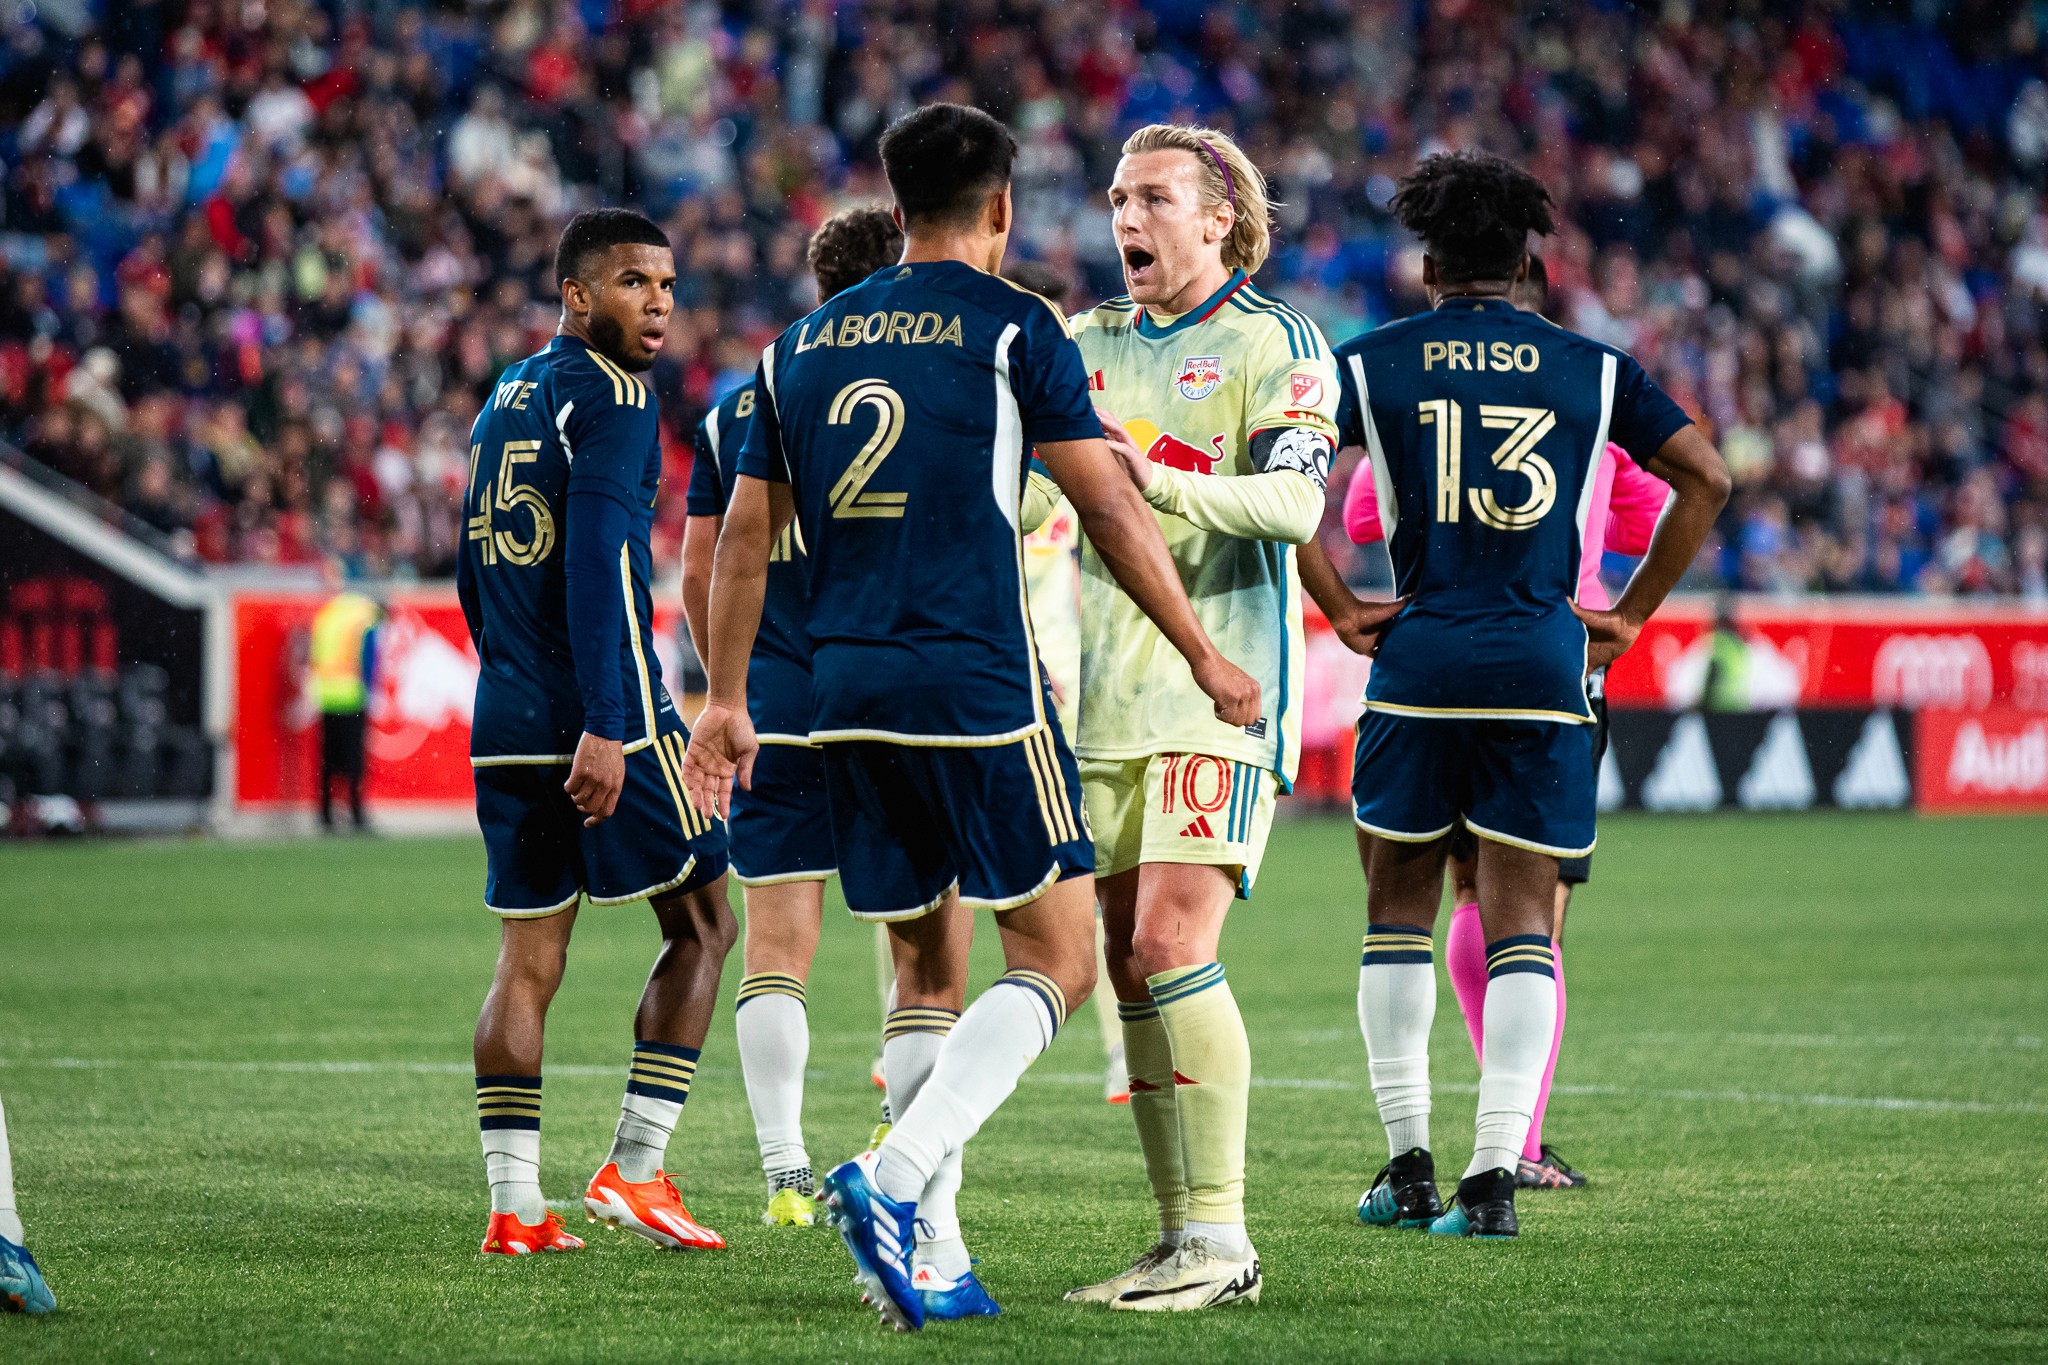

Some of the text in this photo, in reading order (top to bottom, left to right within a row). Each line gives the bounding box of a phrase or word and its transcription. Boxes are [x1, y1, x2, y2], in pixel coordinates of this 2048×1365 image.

[795, 311, 963, 354] LABORDA
[1423, 341, 1540, 373] PRISO
[1294, 377, 1311, 387] MLS
[827, 378, 908, 519] 2
[1418, 399, 1557, 531] 13
[468, 440, 556, 567] 45
[1161, 753, 1232, 814] 10
[1947, 717, 2048, 794] Aud
